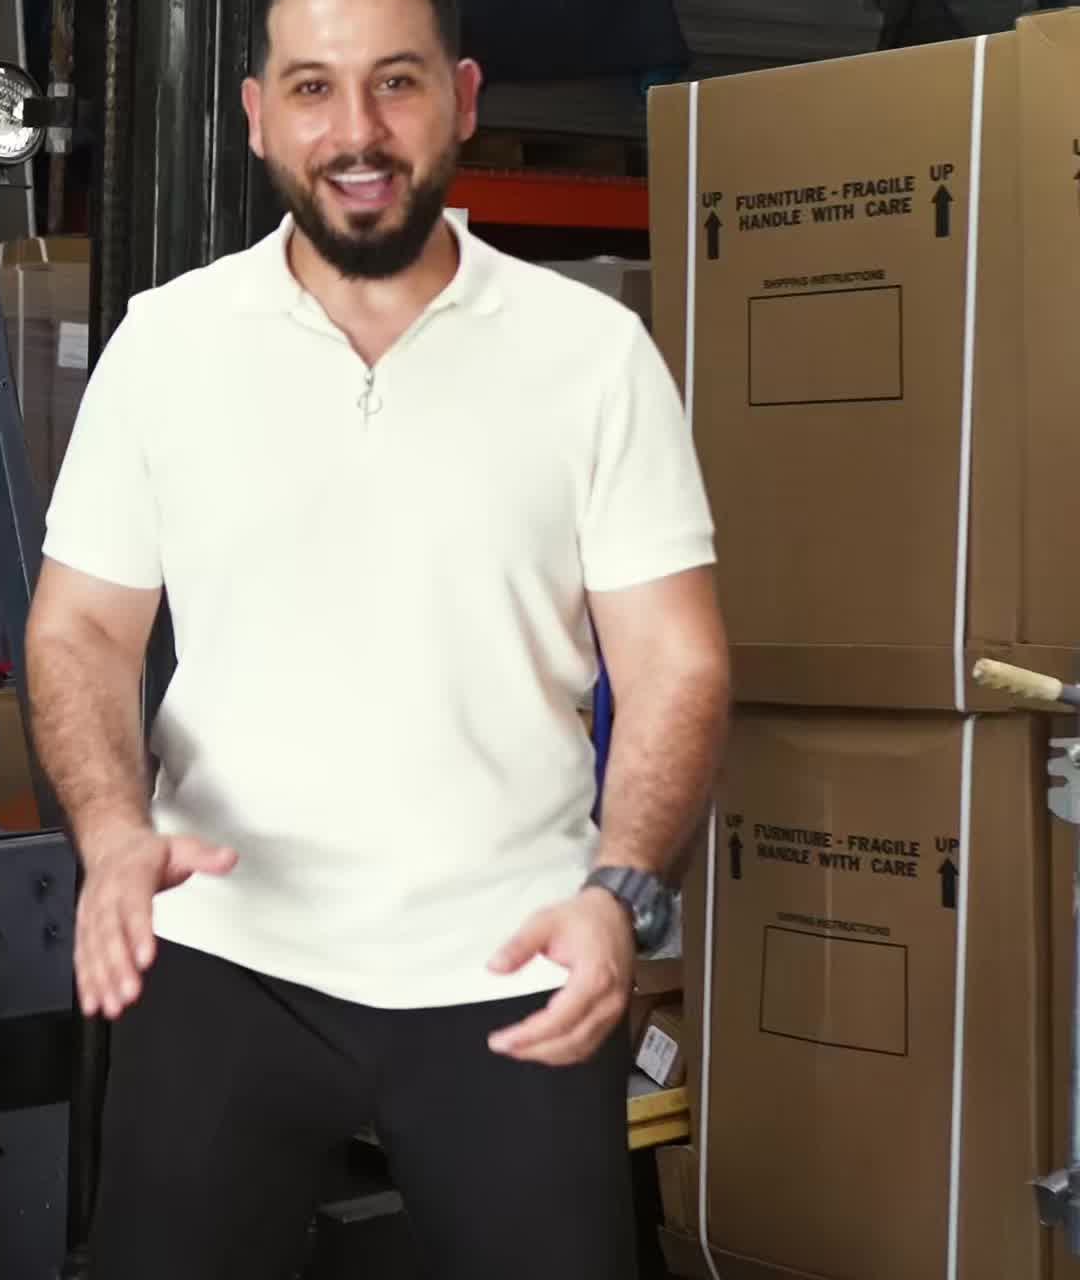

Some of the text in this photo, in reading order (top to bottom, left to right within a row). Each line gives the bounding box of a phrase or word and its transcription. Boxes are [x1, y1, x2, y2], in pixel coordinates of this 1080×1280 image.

[930, 163, 955, 181] UP
[702, 192, 723, 208] UP
[736, 186, 826, 211] FURNITURE
[843, 176, 915, 199] FRAGILE
[739, 198, 912, 231] HANDLE WITH CARE
[753, 824, 832, 848] FURNITURE
[848, 836, 920, 857] FRAGILE
[936, 837, 960, 853] UP
[758, 843, 917, 877] HANDLE WITH CARE
